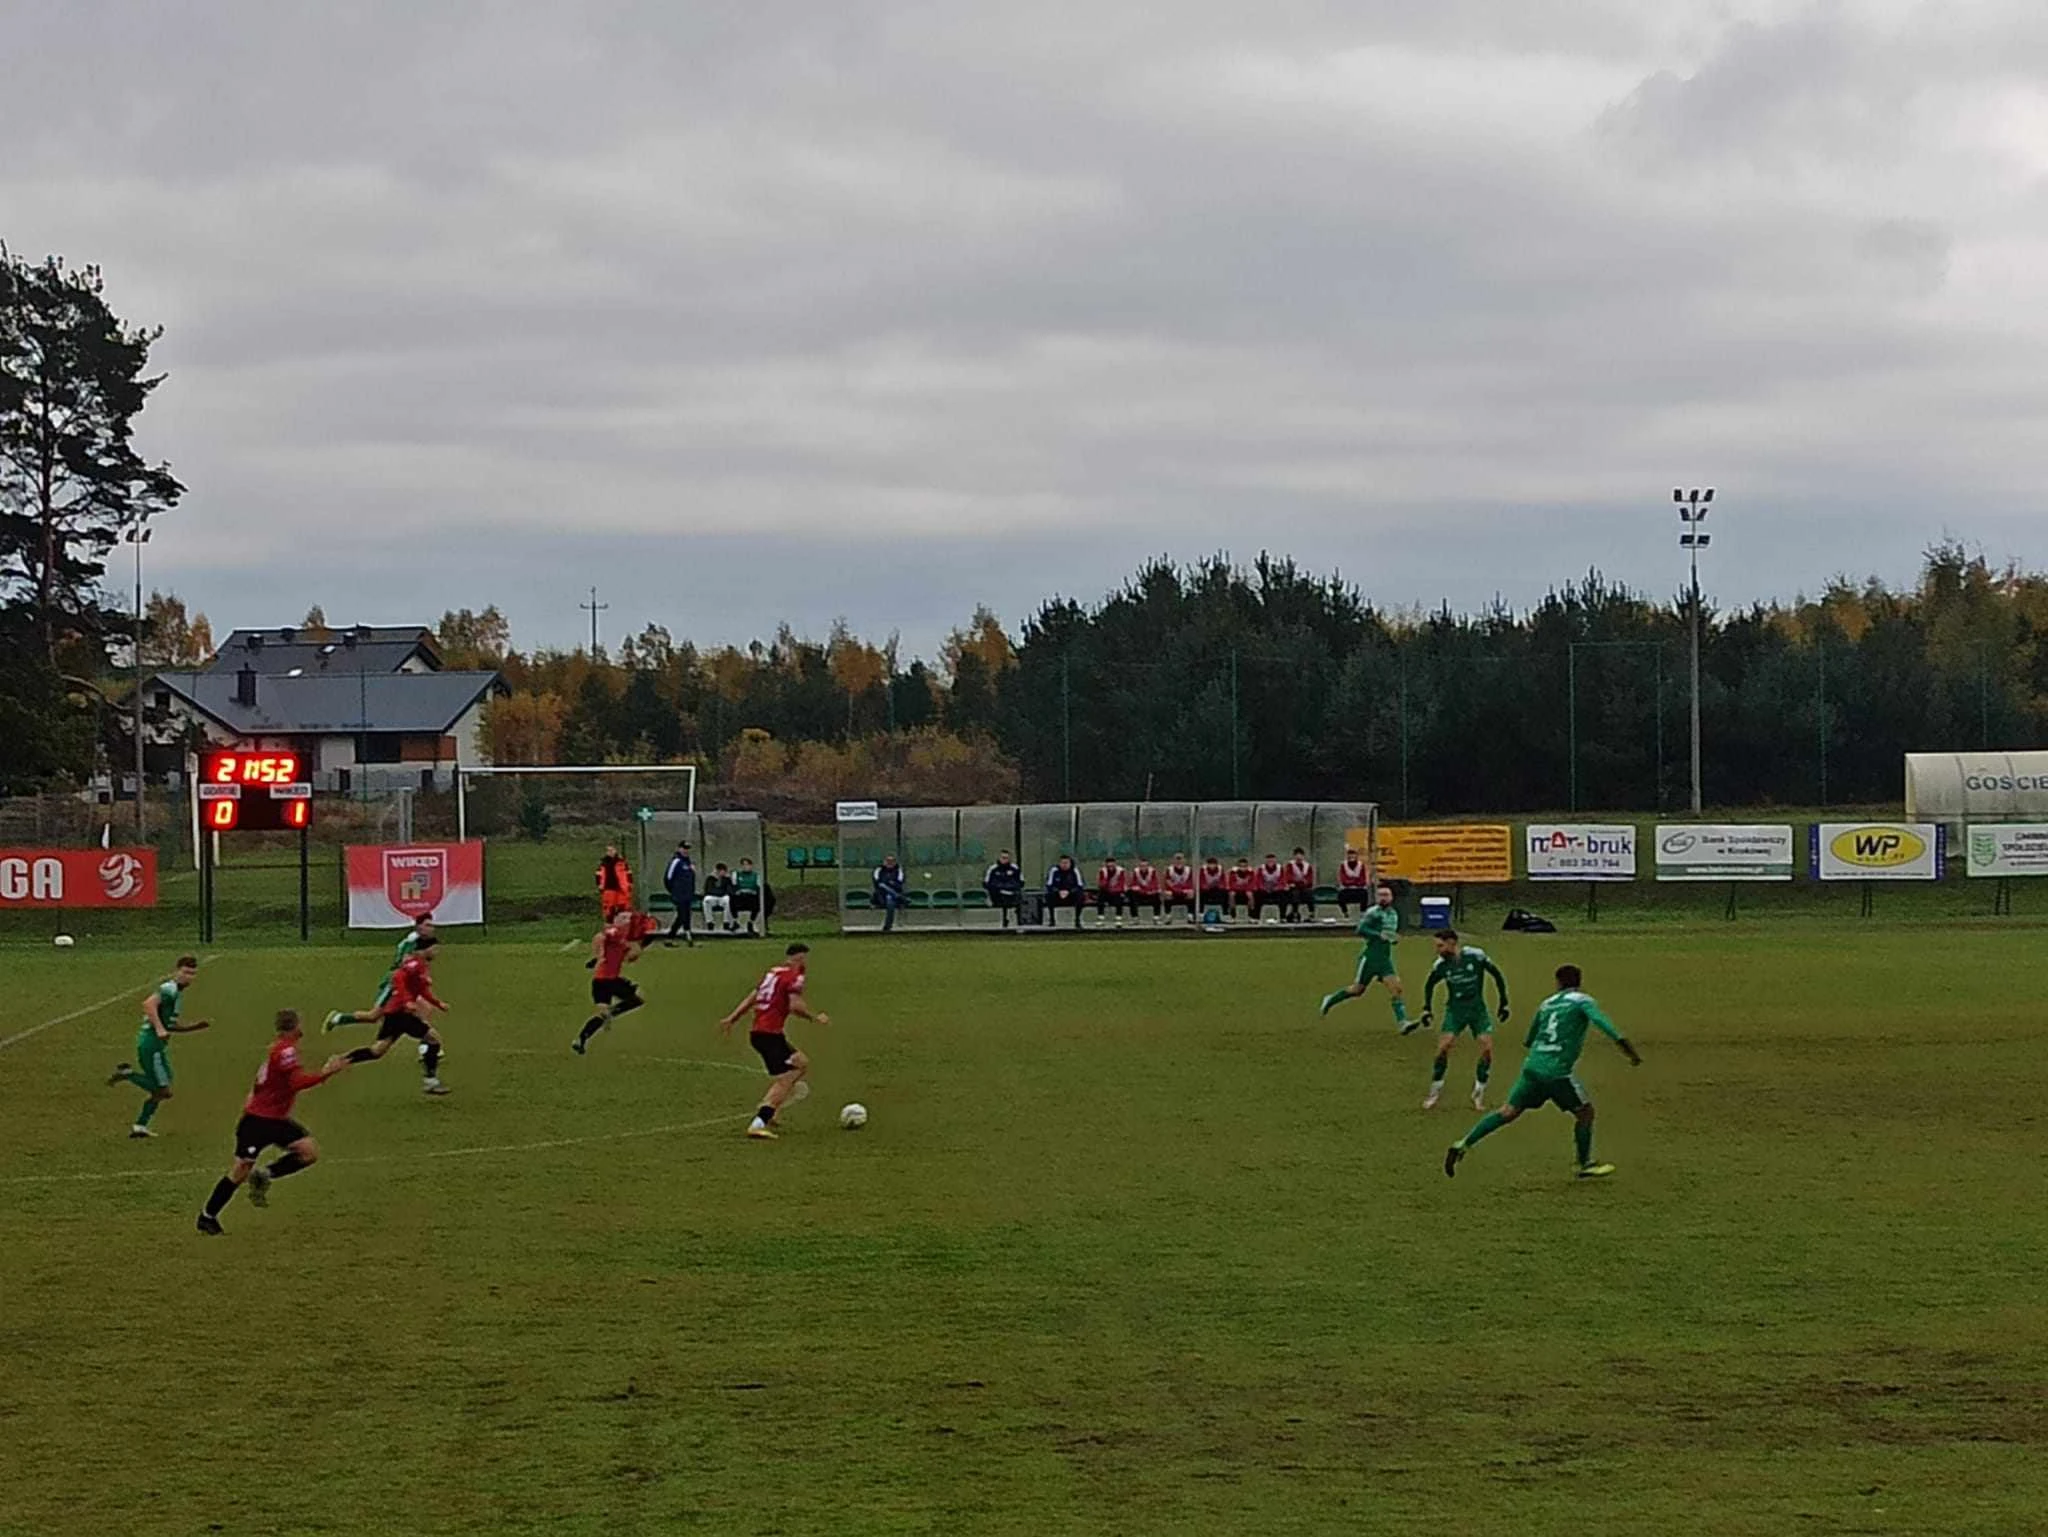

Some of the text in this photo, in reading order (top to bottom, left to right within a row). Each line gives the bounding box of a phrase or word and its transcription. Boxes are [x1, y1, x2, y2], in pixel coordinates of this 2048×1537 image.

[215, 800, 233, 824] 0
[295, 801, 305, 823] 1
[1855, 835, 1900, 855] WP
[0, 857, 63, 899] GA
